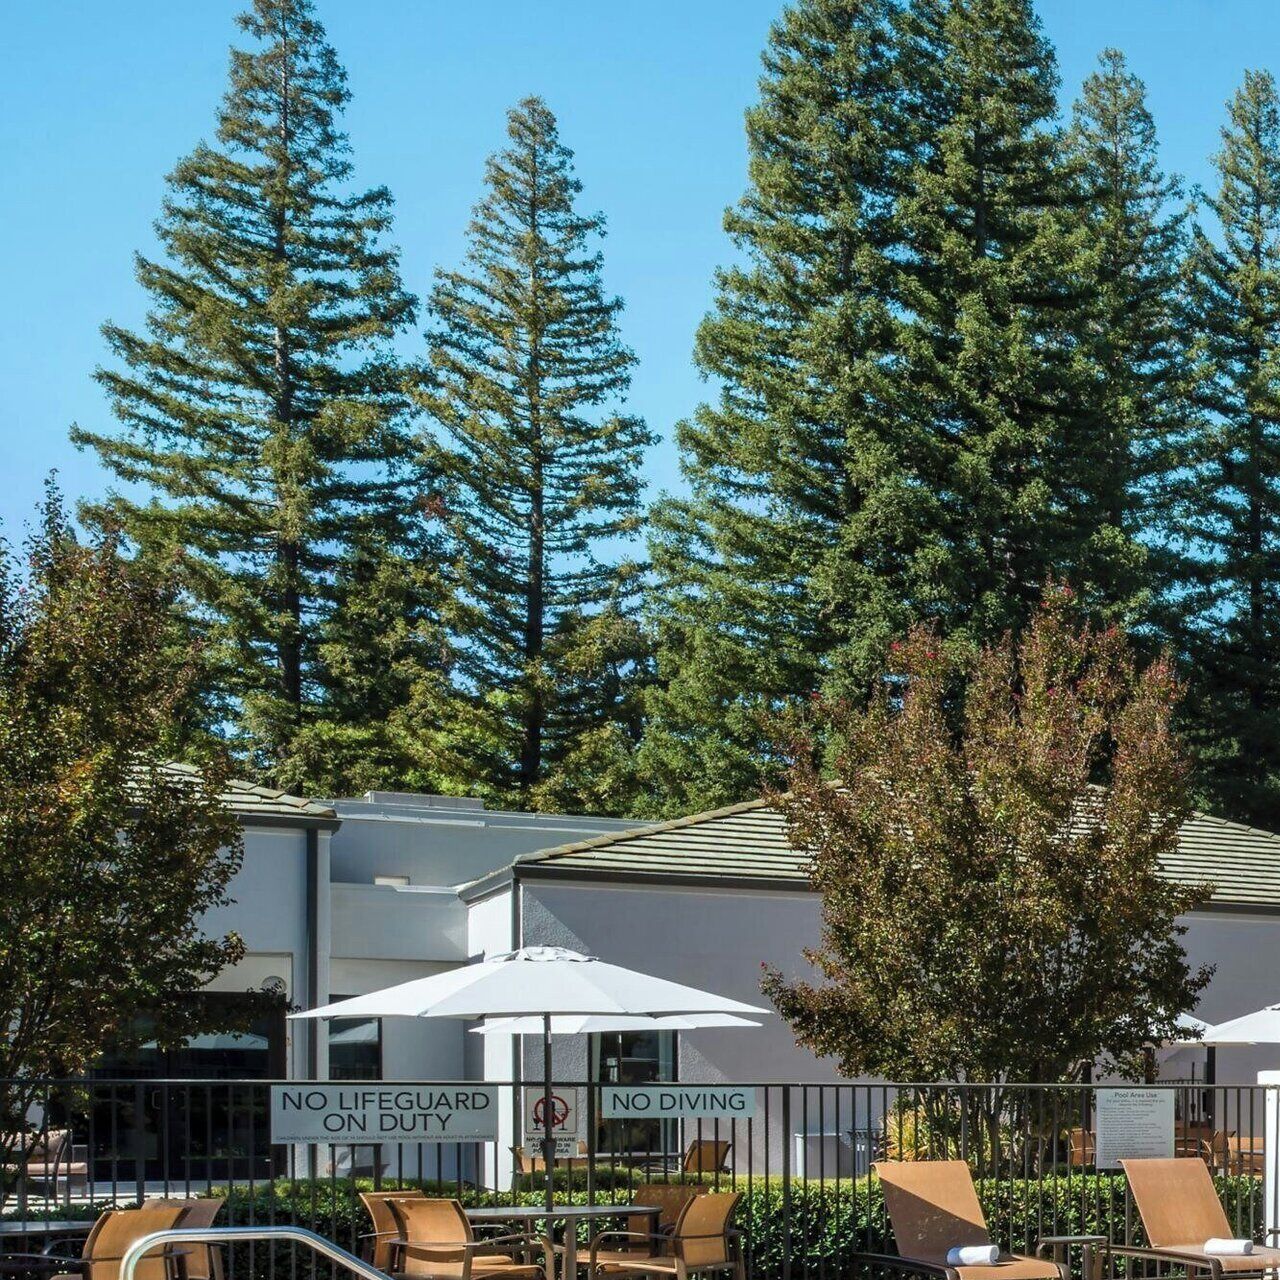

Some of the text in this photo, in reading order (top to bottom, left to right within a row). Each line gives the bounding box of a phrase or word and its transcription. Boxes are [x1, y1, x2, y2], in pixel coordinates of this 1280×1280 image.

[282, 1091, 490, 1111] NO LIFEGUARD
[613, 1092, 746, 1111] NO DIVING
[1114, 1091, 1128, 1099] Pool
[323, 1113, 452, 1132] ON DUTY
